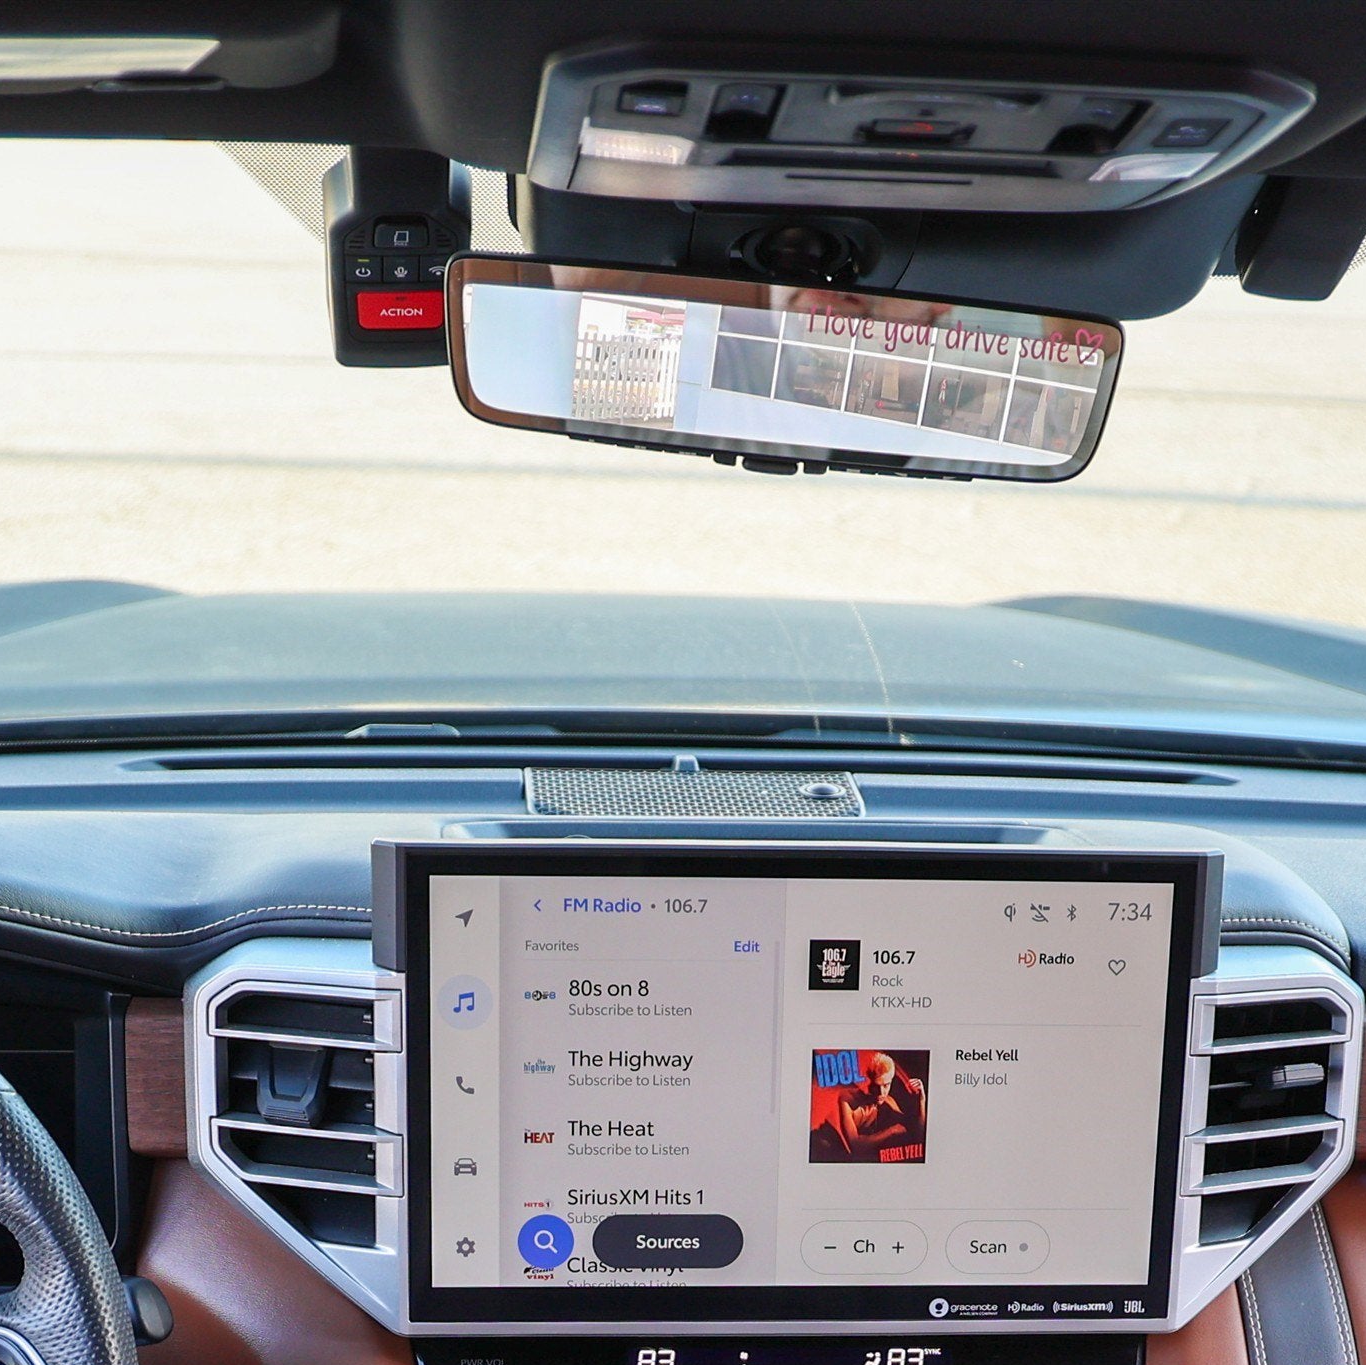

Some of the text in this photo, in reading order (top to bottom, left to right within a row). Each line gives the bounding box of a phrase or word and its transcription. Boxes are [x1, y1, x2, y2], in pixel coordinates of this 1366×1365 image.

[380, 308, 423, 316] ACTION
[824, 305, 875, 340] love
[884, 320, 931, 352] you
[945, 320, 1010, 355] drive
[1018, 331, 1071, 363] safe
[563, 898, 708, 914] FM Radio 106.7
[1108, 902, 1152, 921] 7:34
[524, 939, 579, 953] Favorites
[734, 940, 760, 953] Edit
[822, 948, 847, 962] 106.7
[873, 950, 916, 964] 106.7
[1039, 953, 1075, 965] Radio
[822, 961, 846, 978] Eagle
[872, 975, 904, 987] Rock
[569, 980, 602, 998] 80s
[607, 984, 633, 997] on
[638, 980, 649, 997] 8
[871, 996, 933, 1008] KTKX-HD
[568, 1003, 693, 1017] Subscribe to Listen
[568, 1050, 694, 1072] The Highway
[955, 1047, 1019, 1062] Rebel Yell
[524, 1062, 556, 1073] highway
[815, 1050, 866, 1088] IDOL
[568, 1073, 691, 1087] Subscribe to Listen
[954, 1072, 1008, 1088] Billy Idol
[568, 1120, 655, 1137] The Heat
[524, 1132, 555, 1144] HEAT
[567, 1143, 690, 1156] Subscribe to Listen
[567, 1189, 704, 1205] SiriusXM Hits 1
[636, 1235, 700, 1249] Sources
[853, 1239, 876, 1253] Ch
[969, 1240, 1007, 1254] Scan
[950, 1304, 998, 1313] gracenote
[1021, 1303, 1044, 1312] Radio
[1125, 1301, 1145, 1313] JBL
